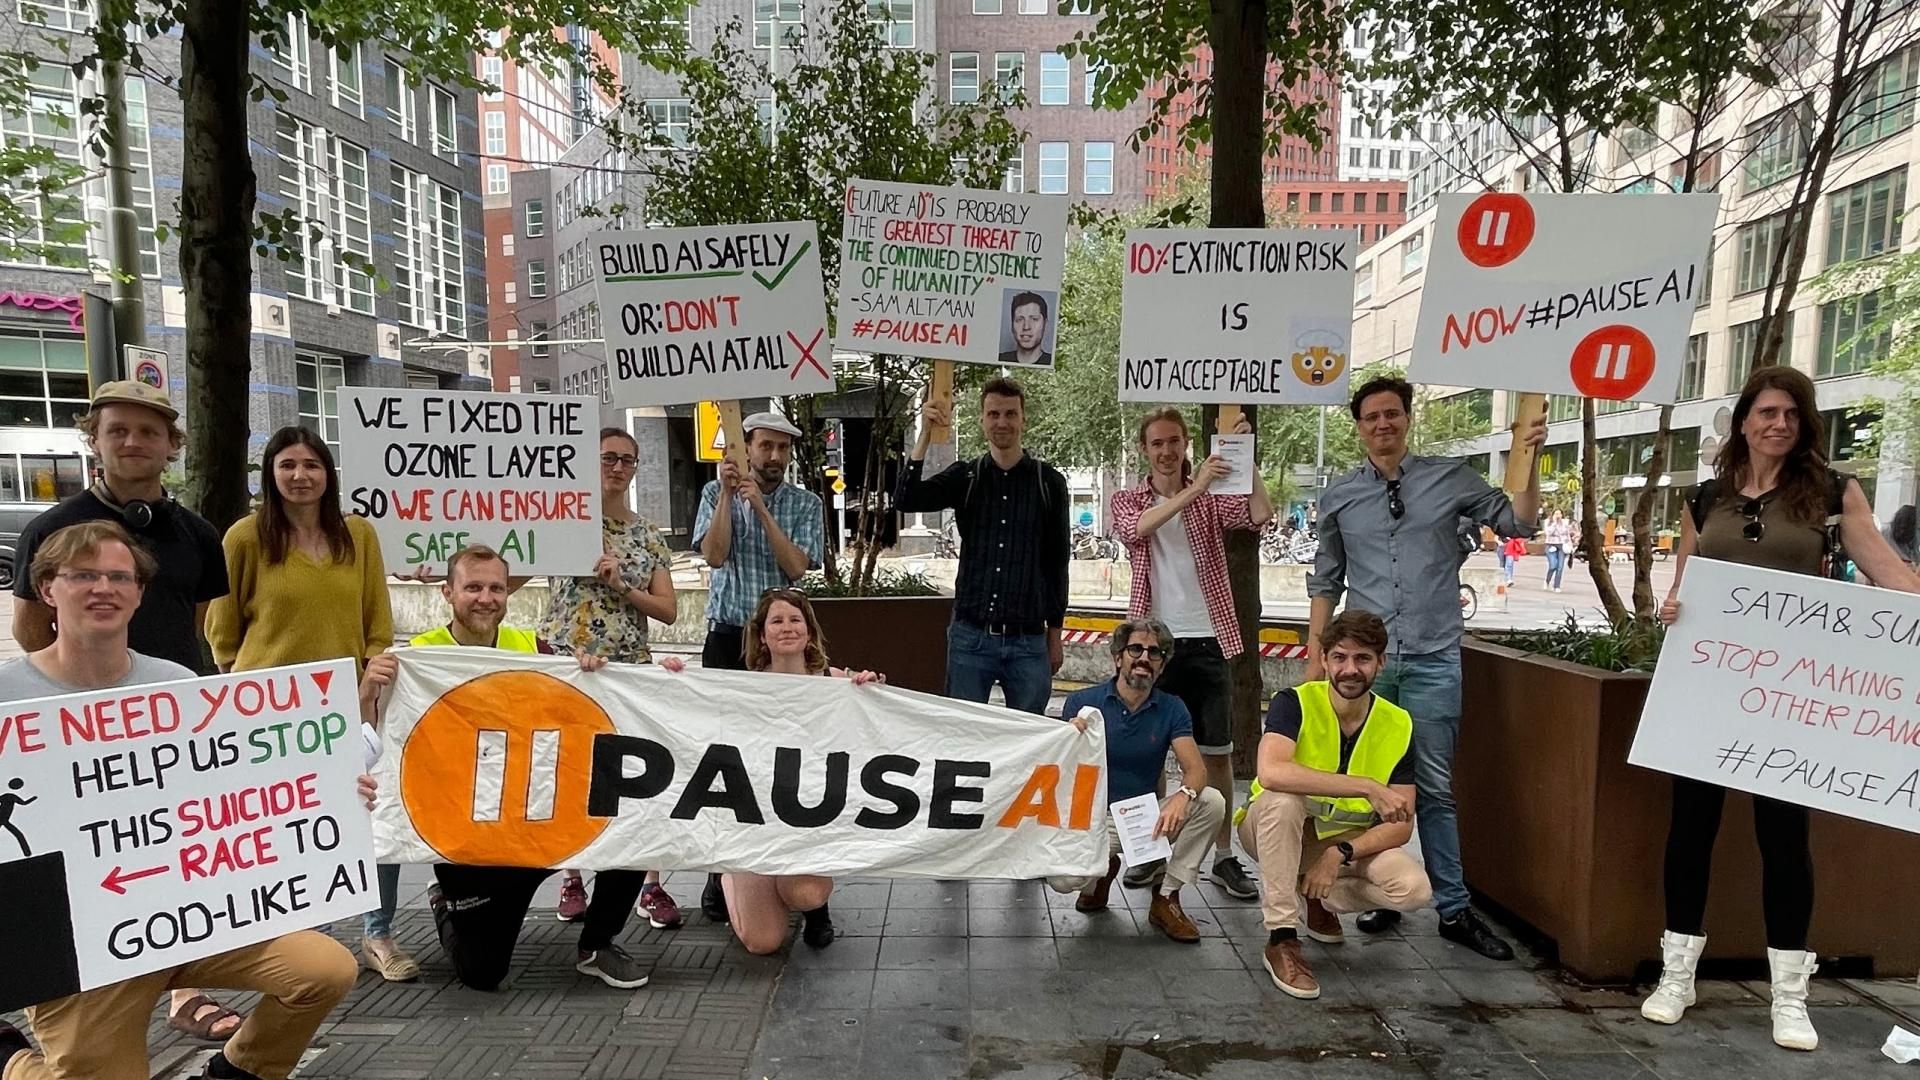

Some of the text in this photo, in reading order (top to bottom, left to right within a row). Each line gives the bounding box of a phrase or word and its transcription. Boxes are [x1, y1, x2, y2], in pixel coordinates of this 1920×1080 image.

[956, 199, 1031, 225] PROBABLY
[600, 233, 790, 275] BUILD AI SAFELY
[850, 214, 1042, 254] THE GREATEST THREAT TO
[848, 239, 1042, 280] THE CONTINUED EXISTENCE
[862, 266, 888, 289] OF
[1130, 240, 1348, 275] 10% EXTINCTION RISK
[621, 295, 741, 336] OR: DON'T
[905, 295, 976, 319] ALTMAN
[1221, 302, 1249, 331] IS
[1441, 264, 1695, 354] NOW #PAUSE AI
[852, 318, 968, 347] #PAUSE AI
[616, 335, 790, 381] BUILD AI AT ALL
[1125, 358, 1283, 393] NOT ACCEPTABLE
[354, 397, 583, 435] WE FIXED THE
[384, 442, 576, 480] OZONE LAYER
[351, 487, 592, 522] SO WE CAN ENSURE
[499, 528, 535, 564] AI
[1691, 639, 1779, 679] STOP
[1781, 657, 1904, 701] MAKING
[59, 691, 182, 745] NEED
[1739, 687, 1850, 730] OTHER
[72, 742, 180, 798] HELP
[188, 731, 239, 772] US
[250, 712, 347, 764] STOP
[587, 732, 1100, 830] PAUSE AI
[1715, 740, 1920, 812] #PAUSE A
[79, 772, 321, 858] THIS SUICIDE
[179, 815, 340, 882] RACE TO
[108, 859, 368, 960] GOD-LIKE AI
